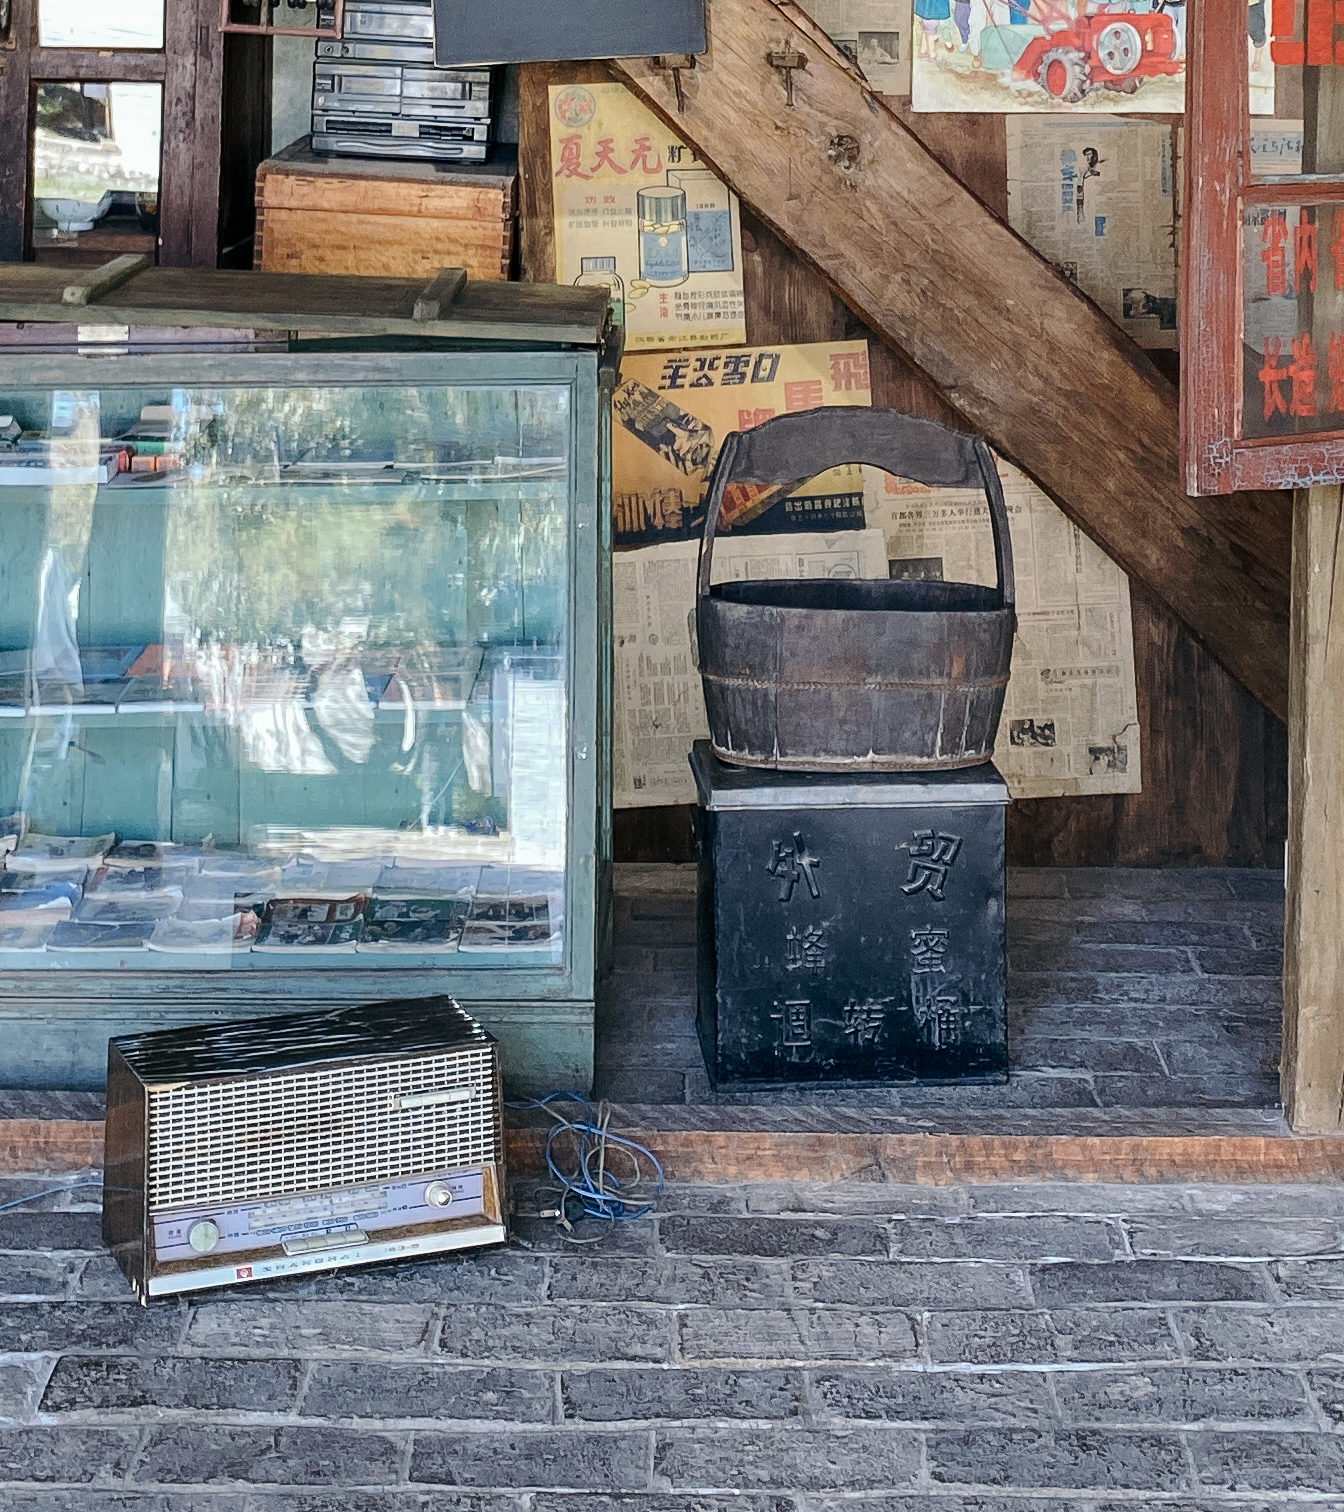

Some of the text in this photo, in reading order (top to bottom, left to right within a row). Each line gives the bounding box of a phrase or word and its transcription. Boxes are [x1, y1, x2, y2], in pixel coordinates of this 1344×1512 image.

[555, 134, 664, 180] 夏天无
[766, 829, 963, 902] 外贸
[785, 924, 951, 975] 蜂蜜
